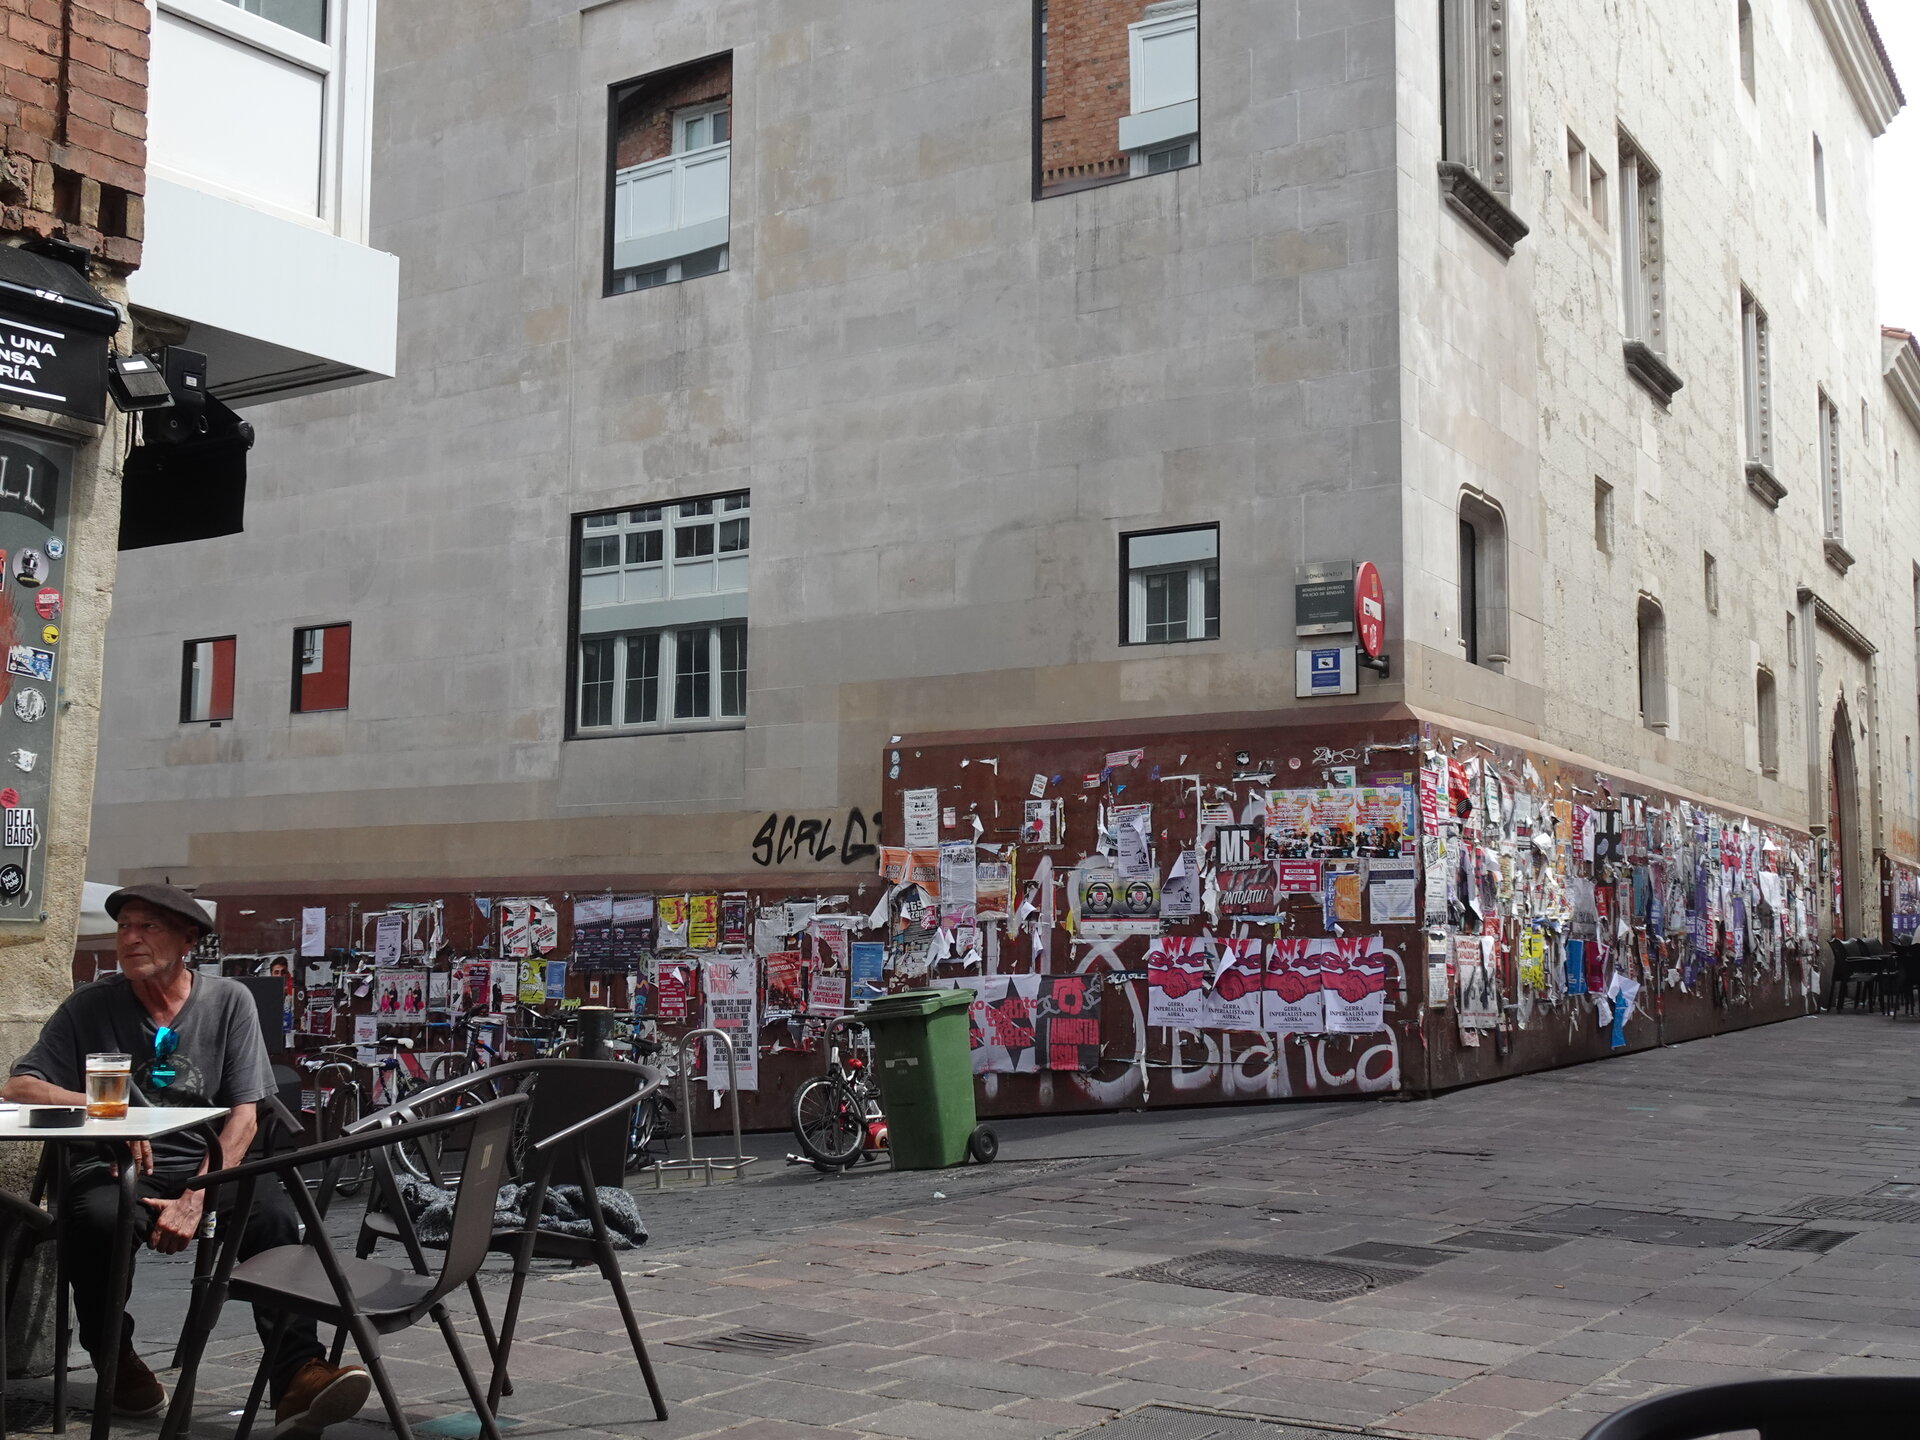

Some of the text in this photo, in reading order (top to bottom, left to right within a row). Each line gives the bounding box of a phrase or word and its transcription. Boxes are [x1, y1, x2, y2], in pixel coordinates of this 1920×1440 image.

[10, 335, 57, 357] UNA
[7, 809, 33, 828] DELA
[6, 827, 33, 845] BAOS
[1221, 889, 1268, 905] ANTOLATU!
[1208, 1007, 1255, 1015] INPERIALISTAREN
